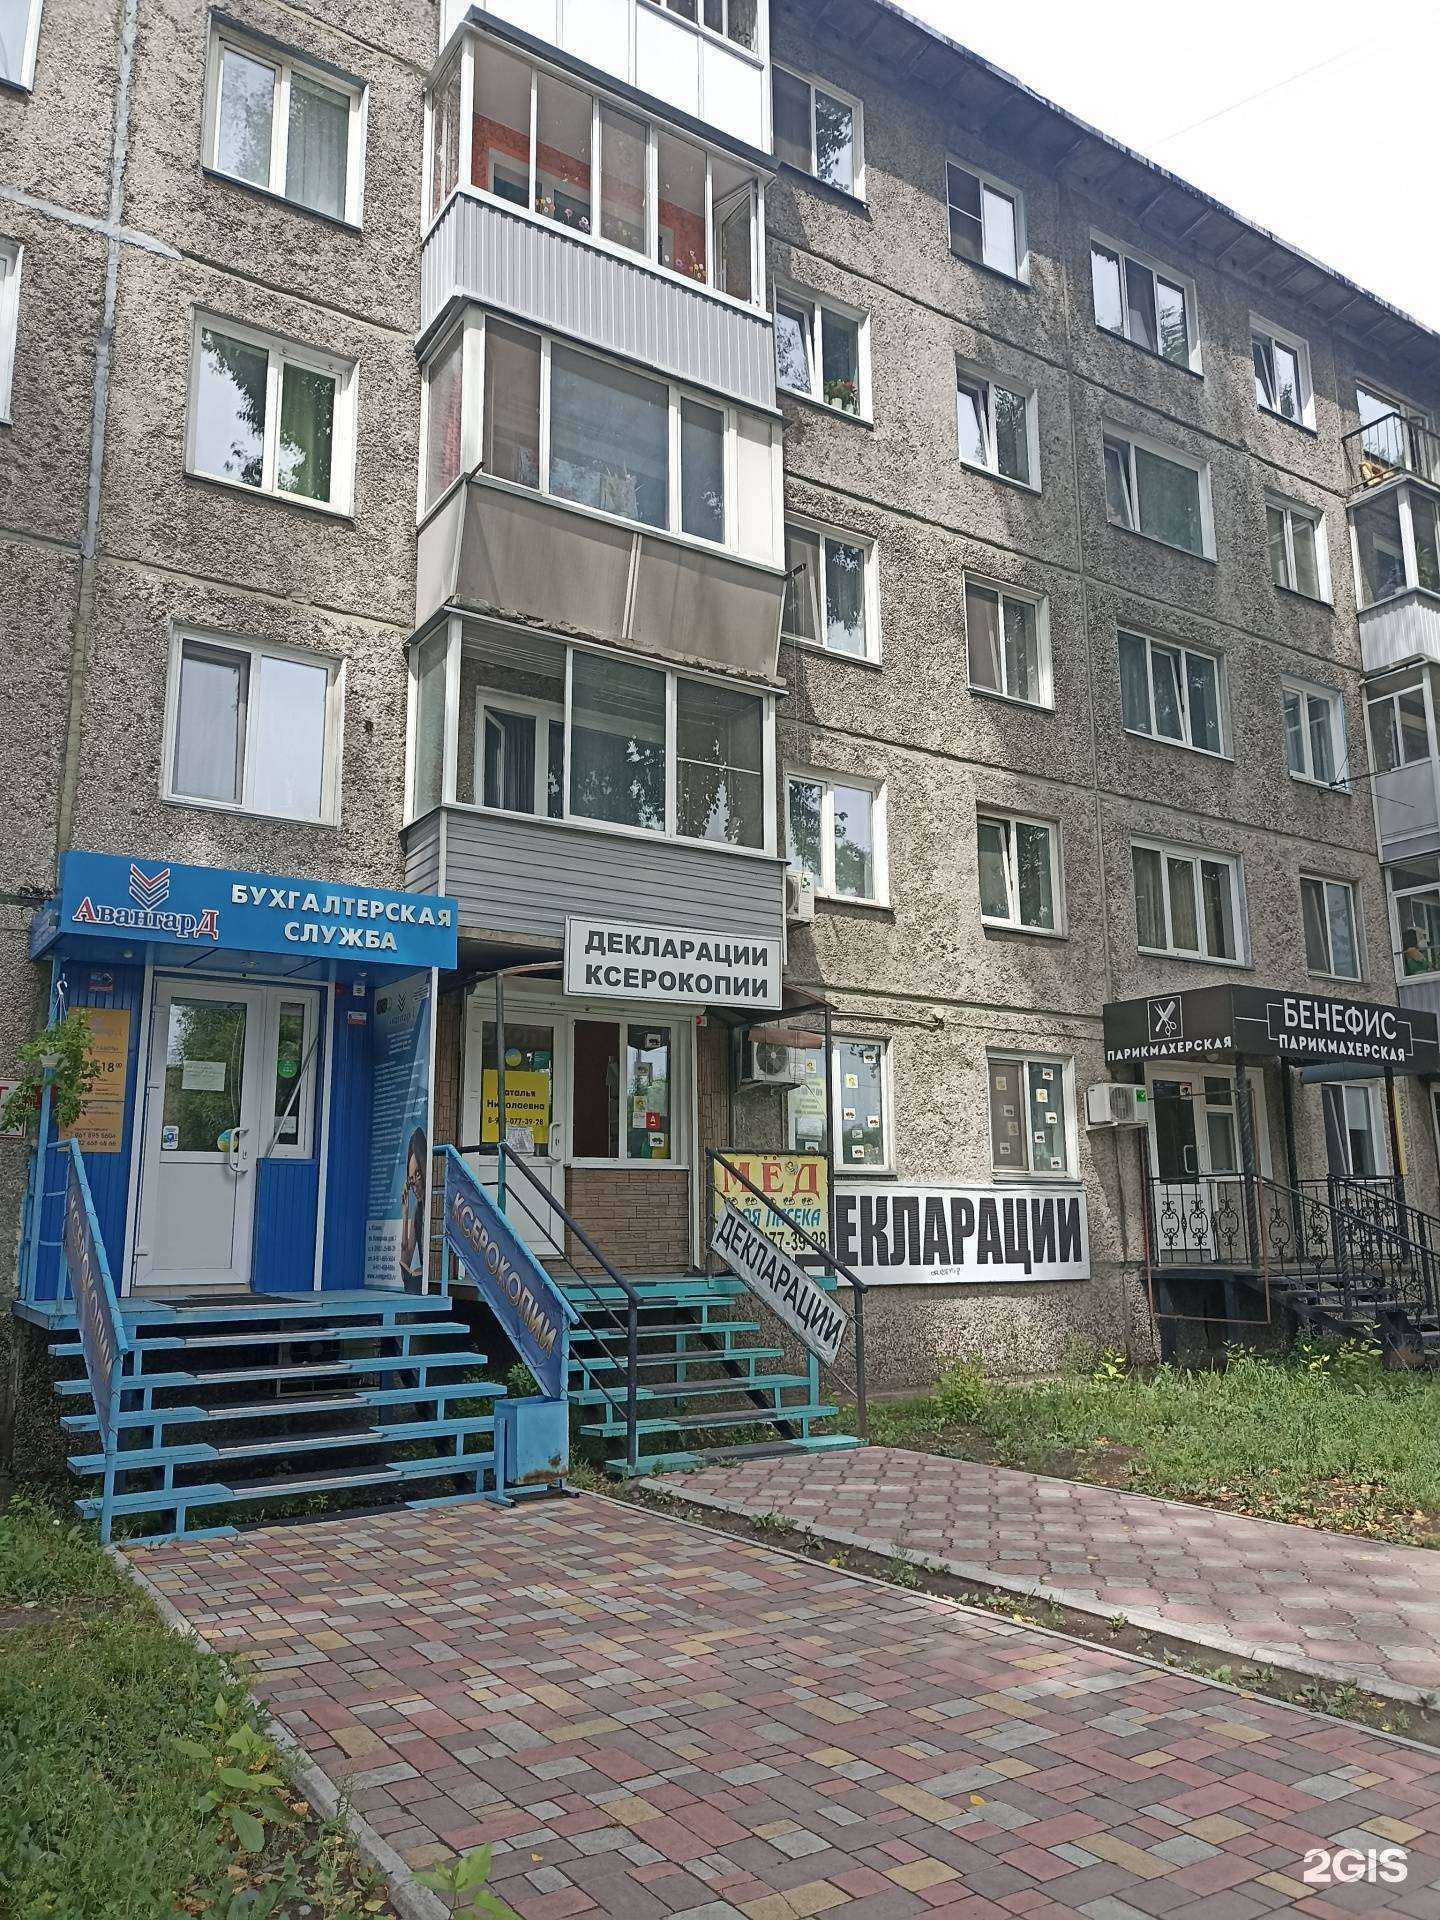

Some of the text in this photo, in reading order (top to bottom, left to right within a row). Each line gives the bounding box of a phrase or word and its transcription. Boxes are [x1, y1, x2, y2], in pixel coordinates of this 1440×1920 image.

[231, 884, 453, 928] БУХГАЛТЕРСКАЯ
[284, 922, 399, 951] СЛУЖБА
[584, 930, 768, 968] ДЕКЛАРАЦИИ
[585, 964, 768, 998] КСЕРОКОПИИ
[1282, 997, 1398, 1040] БЕНЕФИС
[1106, 1035, 1233, 1062] ПАРИКМАХЕРСКАЯ
[1278, 1033, 1406, 1062] ПАРИКМАХЕРСКАЯ
[486, 1098, 545, 1111] Ниолаевна
[503, 1089, 536, 1098] аталья
[722, 1155, 820, 1200] МЁД
[452, 1192, 558, 1360] КСЕРОКОПИИ
[715, 1211, 843, 1350] ДЕКЛАРАЦИИ
